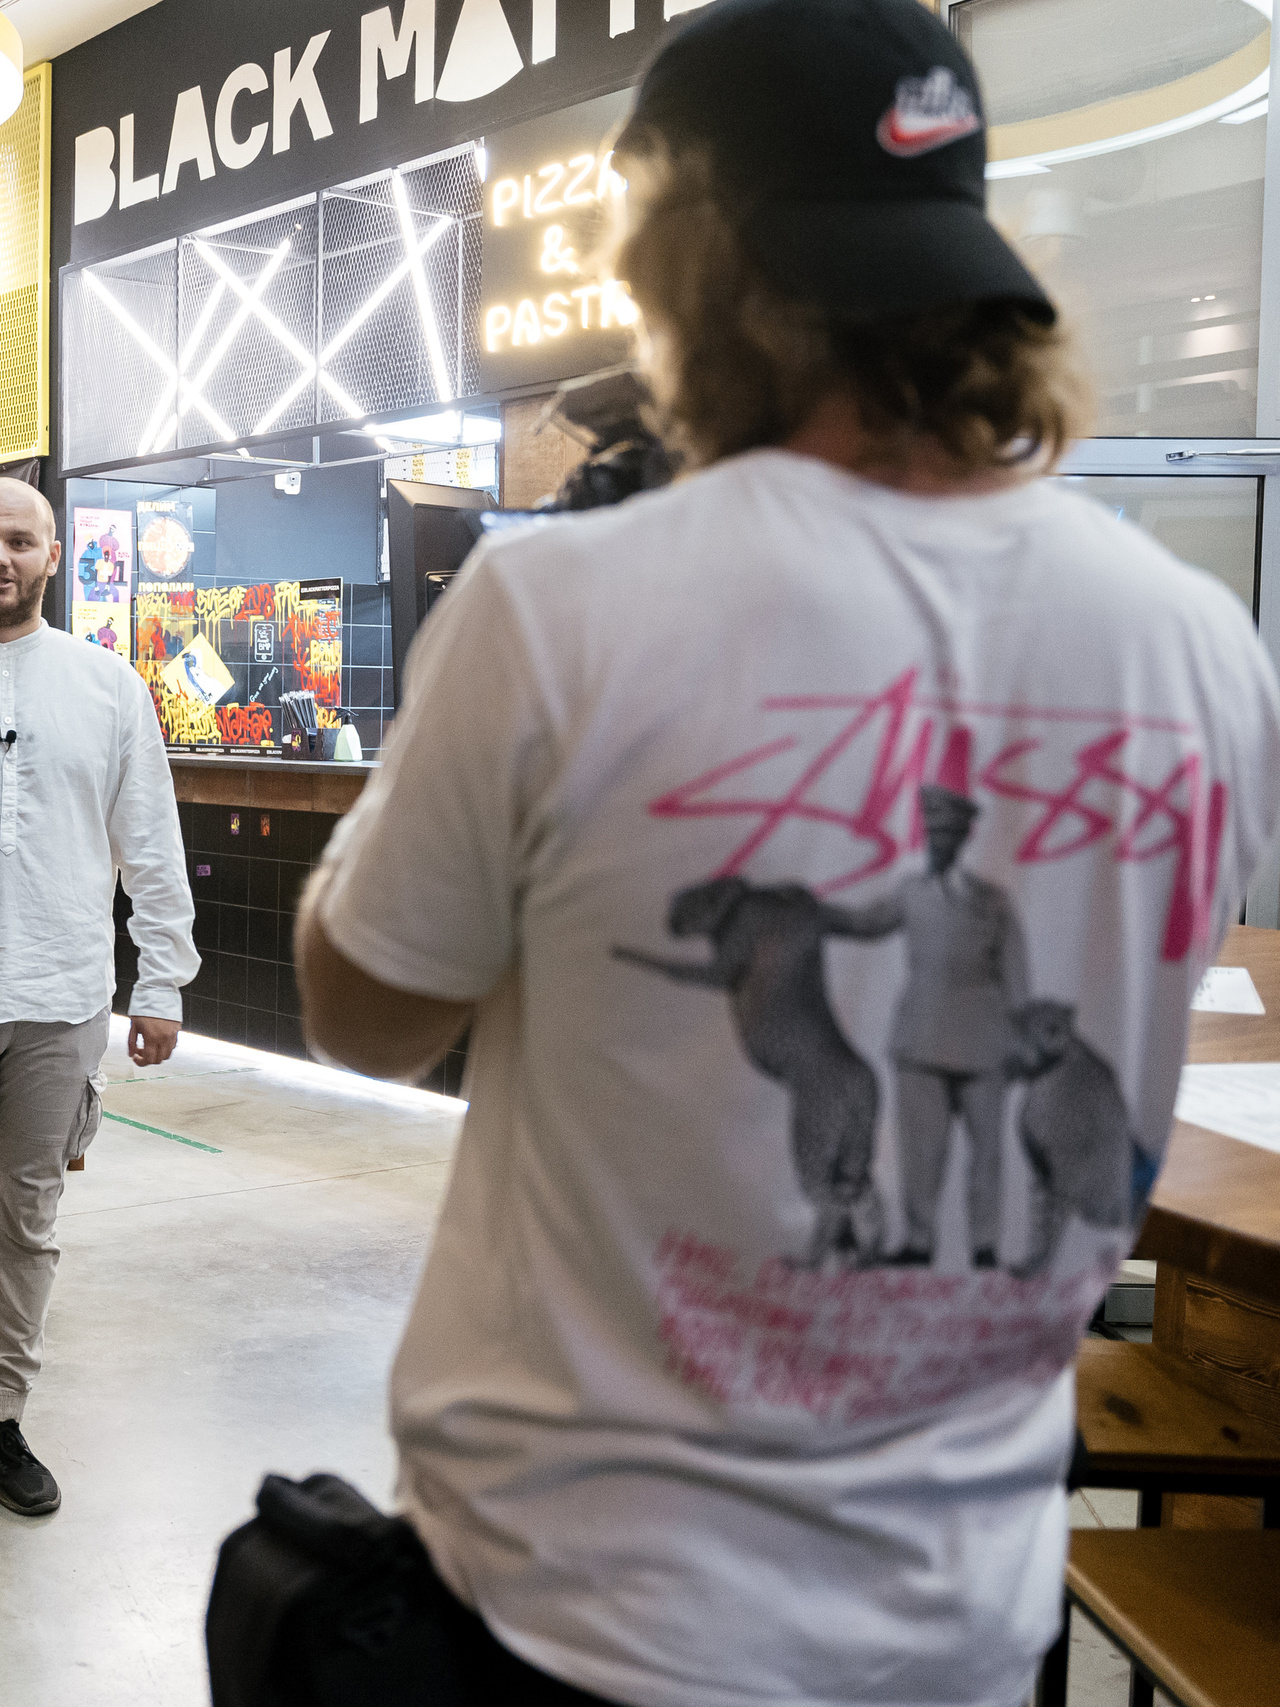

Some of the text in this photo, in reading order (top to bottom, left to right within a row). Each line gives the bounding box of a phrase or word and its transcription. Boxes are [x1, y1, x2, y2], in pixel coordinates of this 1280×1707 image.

[74, 29, 334, 226] BLACK
[492, 152, 628, 227] PIZZA
[540, 224, 579, 274] &
